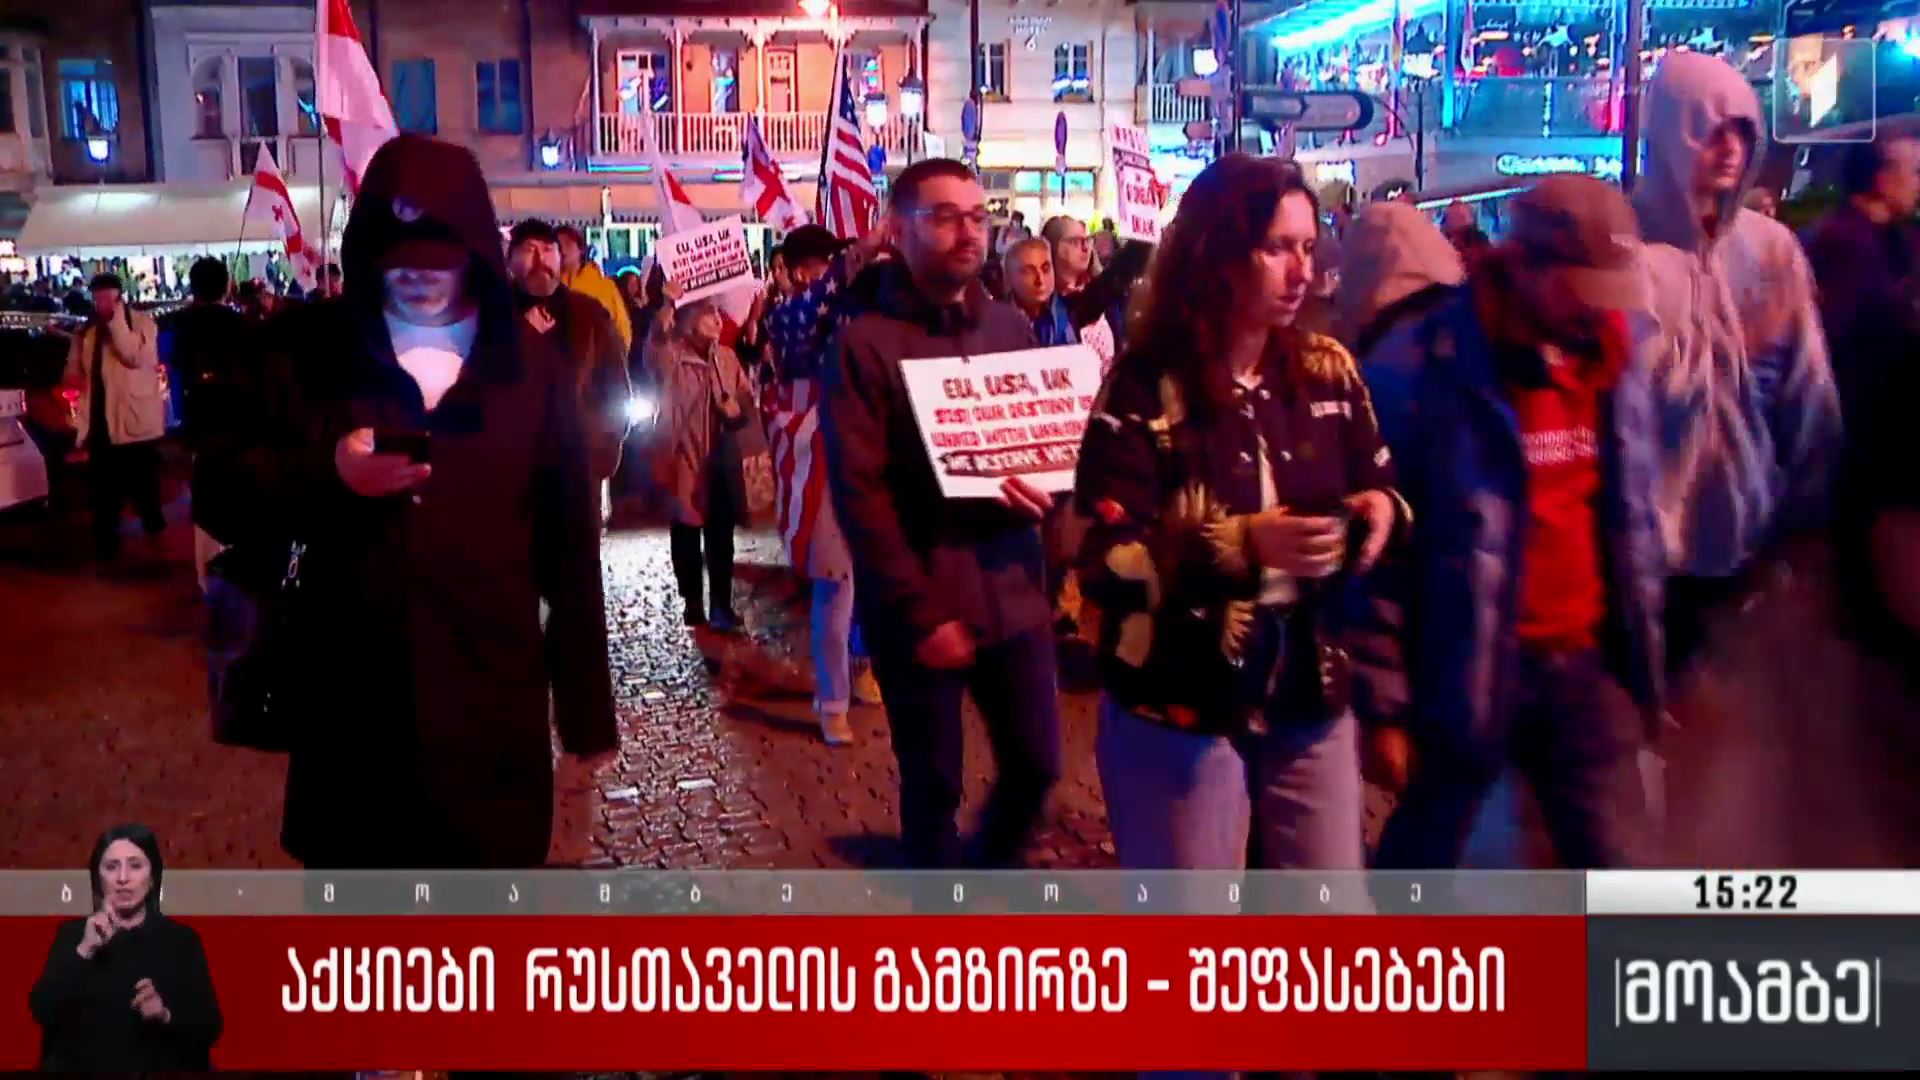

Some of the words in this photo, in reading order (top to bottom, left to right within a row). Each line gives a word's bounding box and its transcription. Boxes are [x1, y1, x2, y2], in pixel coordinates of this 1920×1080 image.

[943, 377, 981, 400] EU,
[984, 373, 1038, 396] USA,
[1040, 367, 1072, 390] UK
[1041, 443, 1080, 465] VICT
